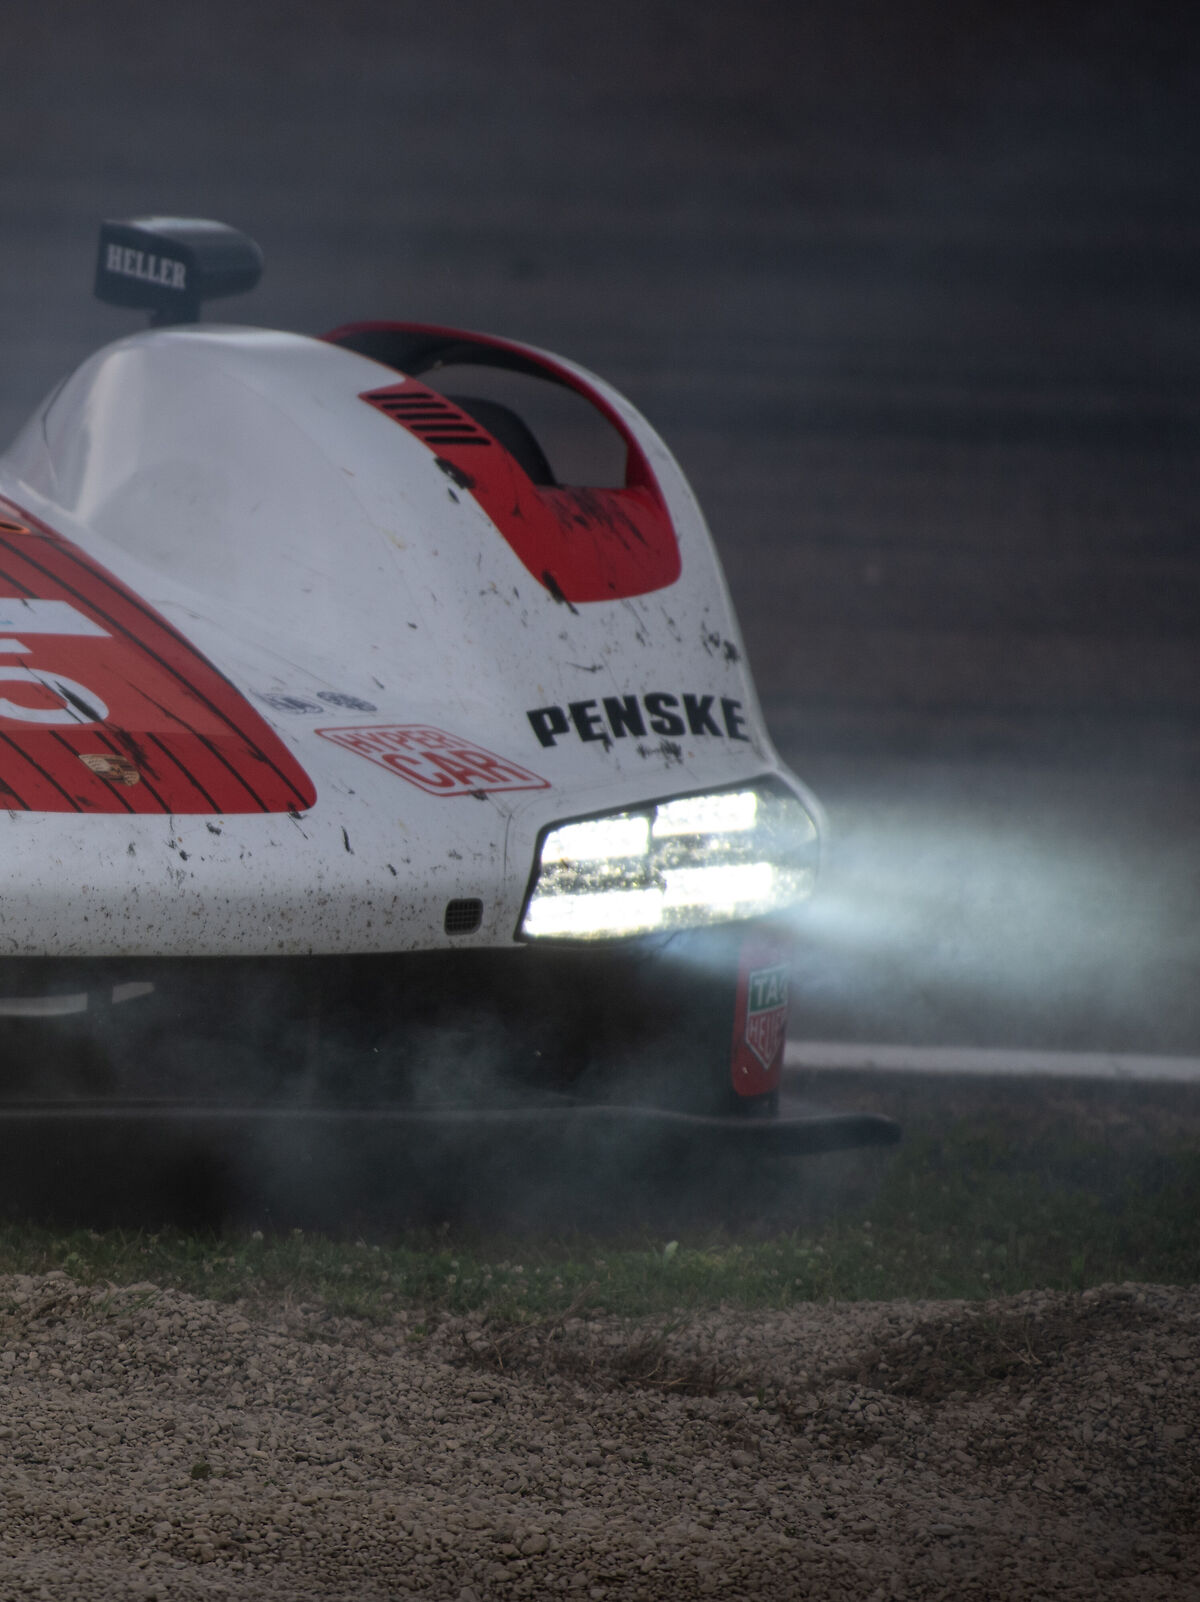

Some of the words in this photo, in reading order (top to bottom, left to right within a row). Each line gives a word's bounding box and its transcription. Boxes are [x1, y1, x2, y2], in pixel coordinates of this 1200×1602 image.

[106, 243, 187, 290] HELLER
[330, 729, 472, 753] HYPER
[526, 691, 750, 749] PENSKE
[381, 749, 533, 788] CAR
[750, 1008, 784, 1060] HEU
